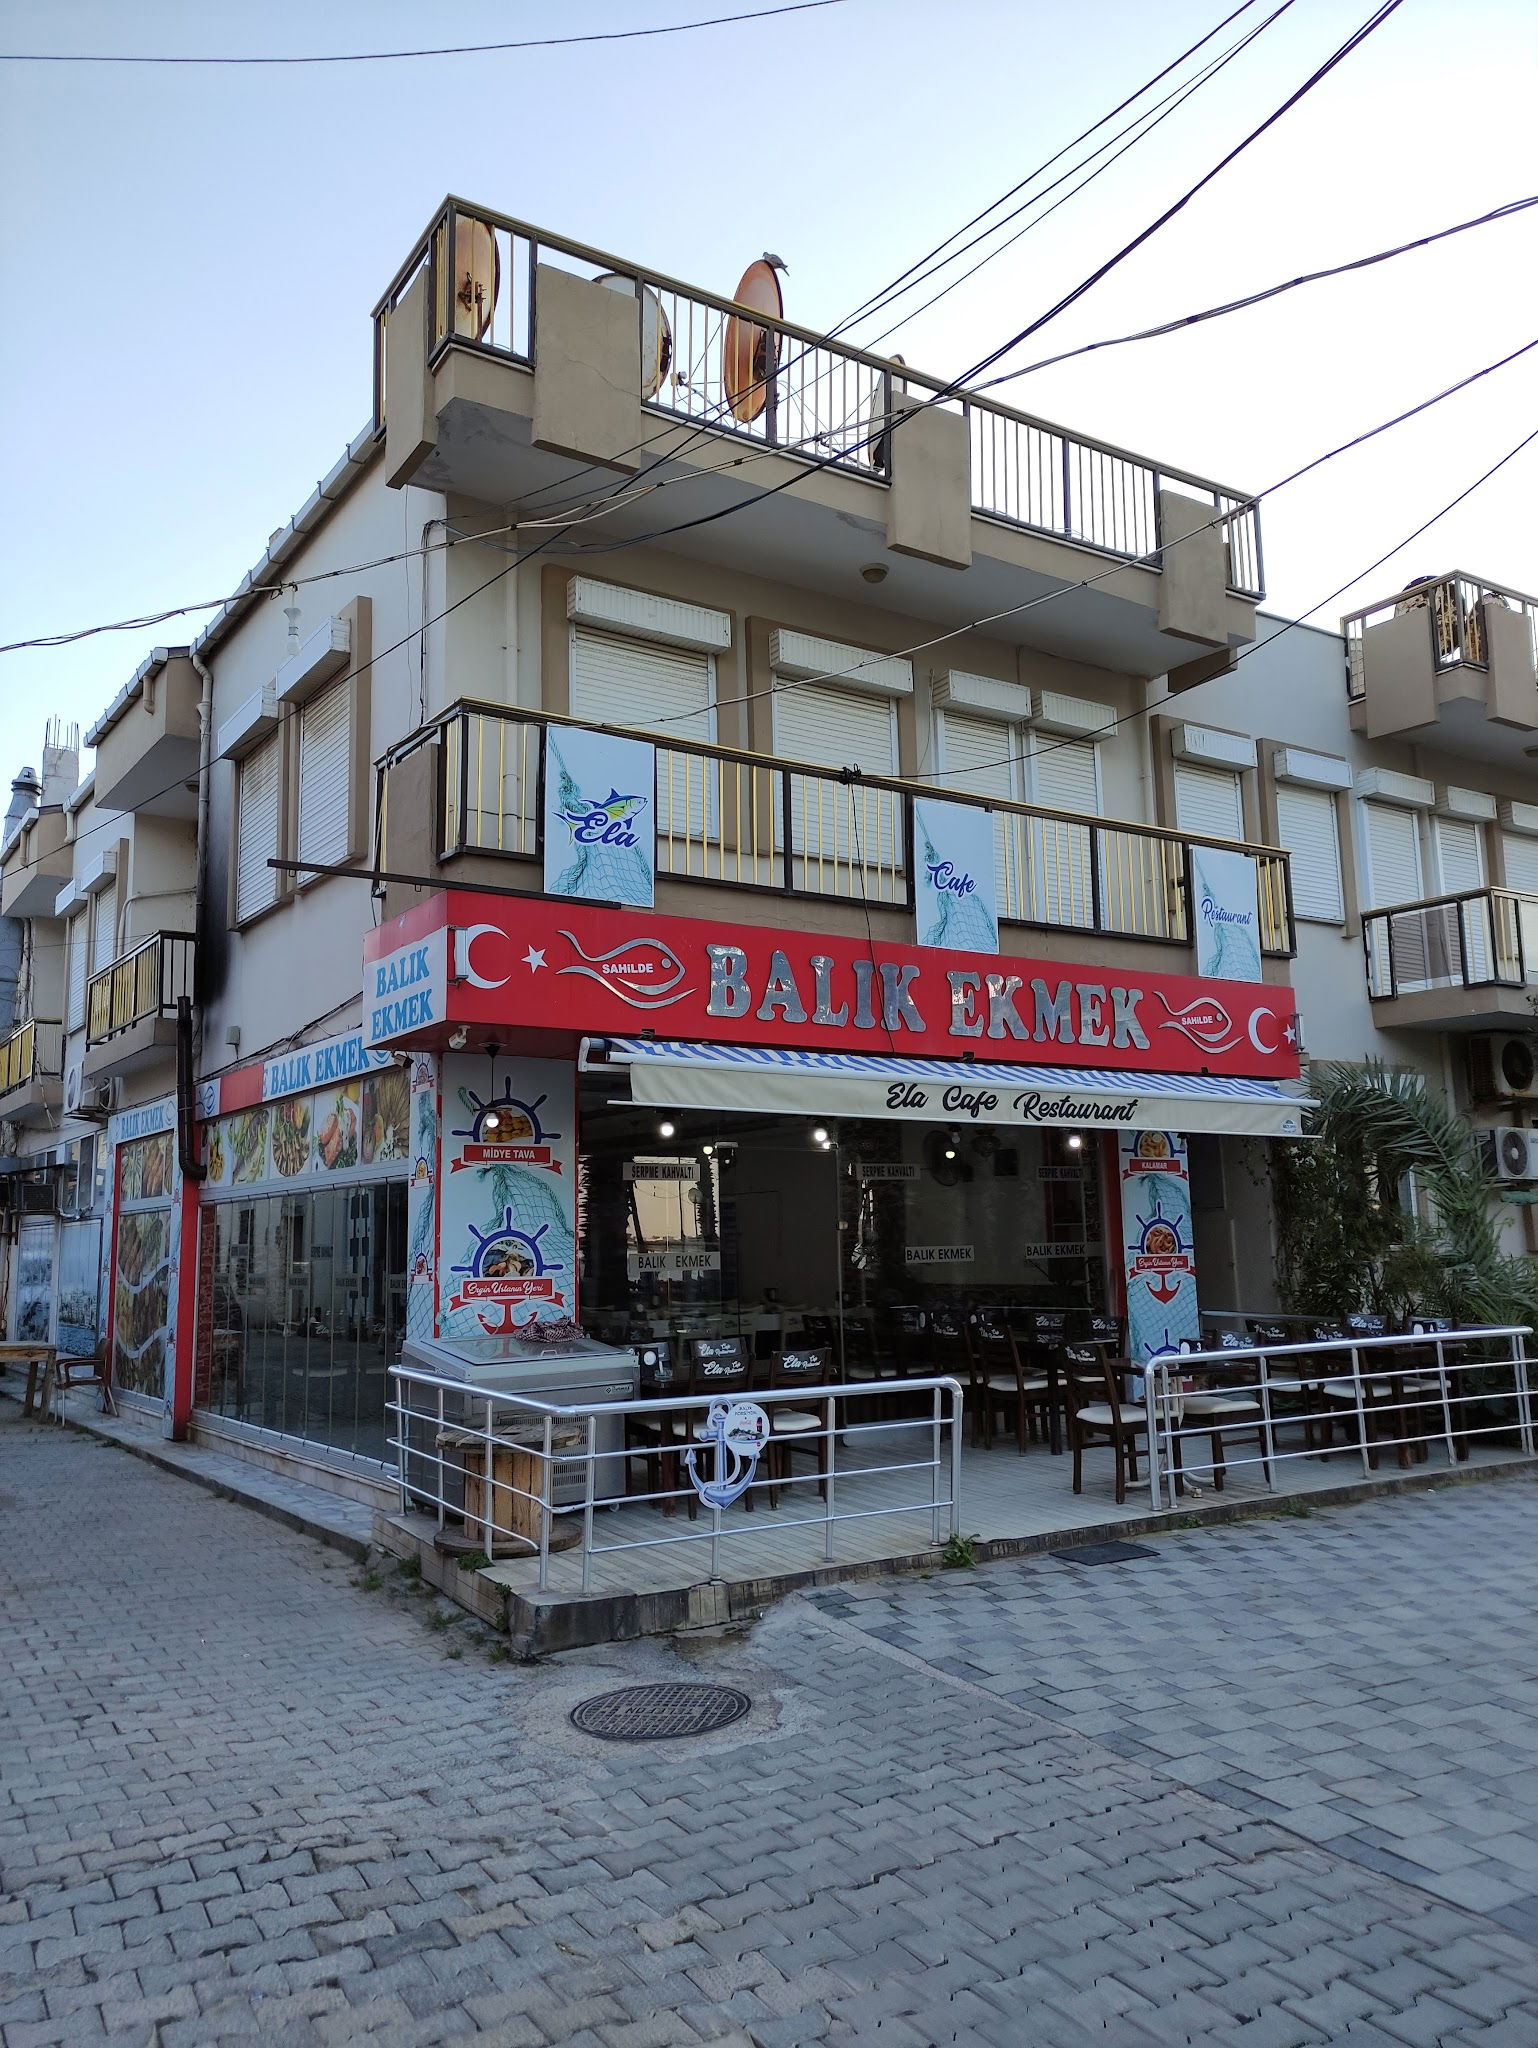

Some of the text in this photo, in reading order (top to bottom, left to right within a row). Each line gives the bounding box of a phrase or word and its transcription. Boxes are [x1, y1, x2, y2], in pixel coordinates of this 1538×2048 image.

[567, 811, 640, 847] Ela
[927, 861, 977, 897] Cafe
[1201, 898, 1252, 927] Restaurant
[376, 946, 430, 998] BALIK
[706, 943, 1151, 1050] BALIK EKMEK
[372, 988, 434, 1040] EKMEK
[270, 1053, 312, 1096] BALIK
[314, 1036, 370, 1083] EKMEK
[886, 1082, 1139, 1122] Ela Cafe Restaurant
[483, 1147, 536, 1159] MİDYE TAVA
[631, 1166, 694, 1179] SERPME KAHVALTI
[907, 1249, 972, 1261] BALIK EKMEK
[1026, 1244, 1085, 1256] BALIK EKMEK
[638, 1255, 711, 1268] BALIK EKMEK
[467, 1282, 491, 1296] Ergin
[522, 1281, 544, 1295] Yeri
[702, 1360, 724, 1375] Ela
[782, 1355, 801, 1369] Ela
